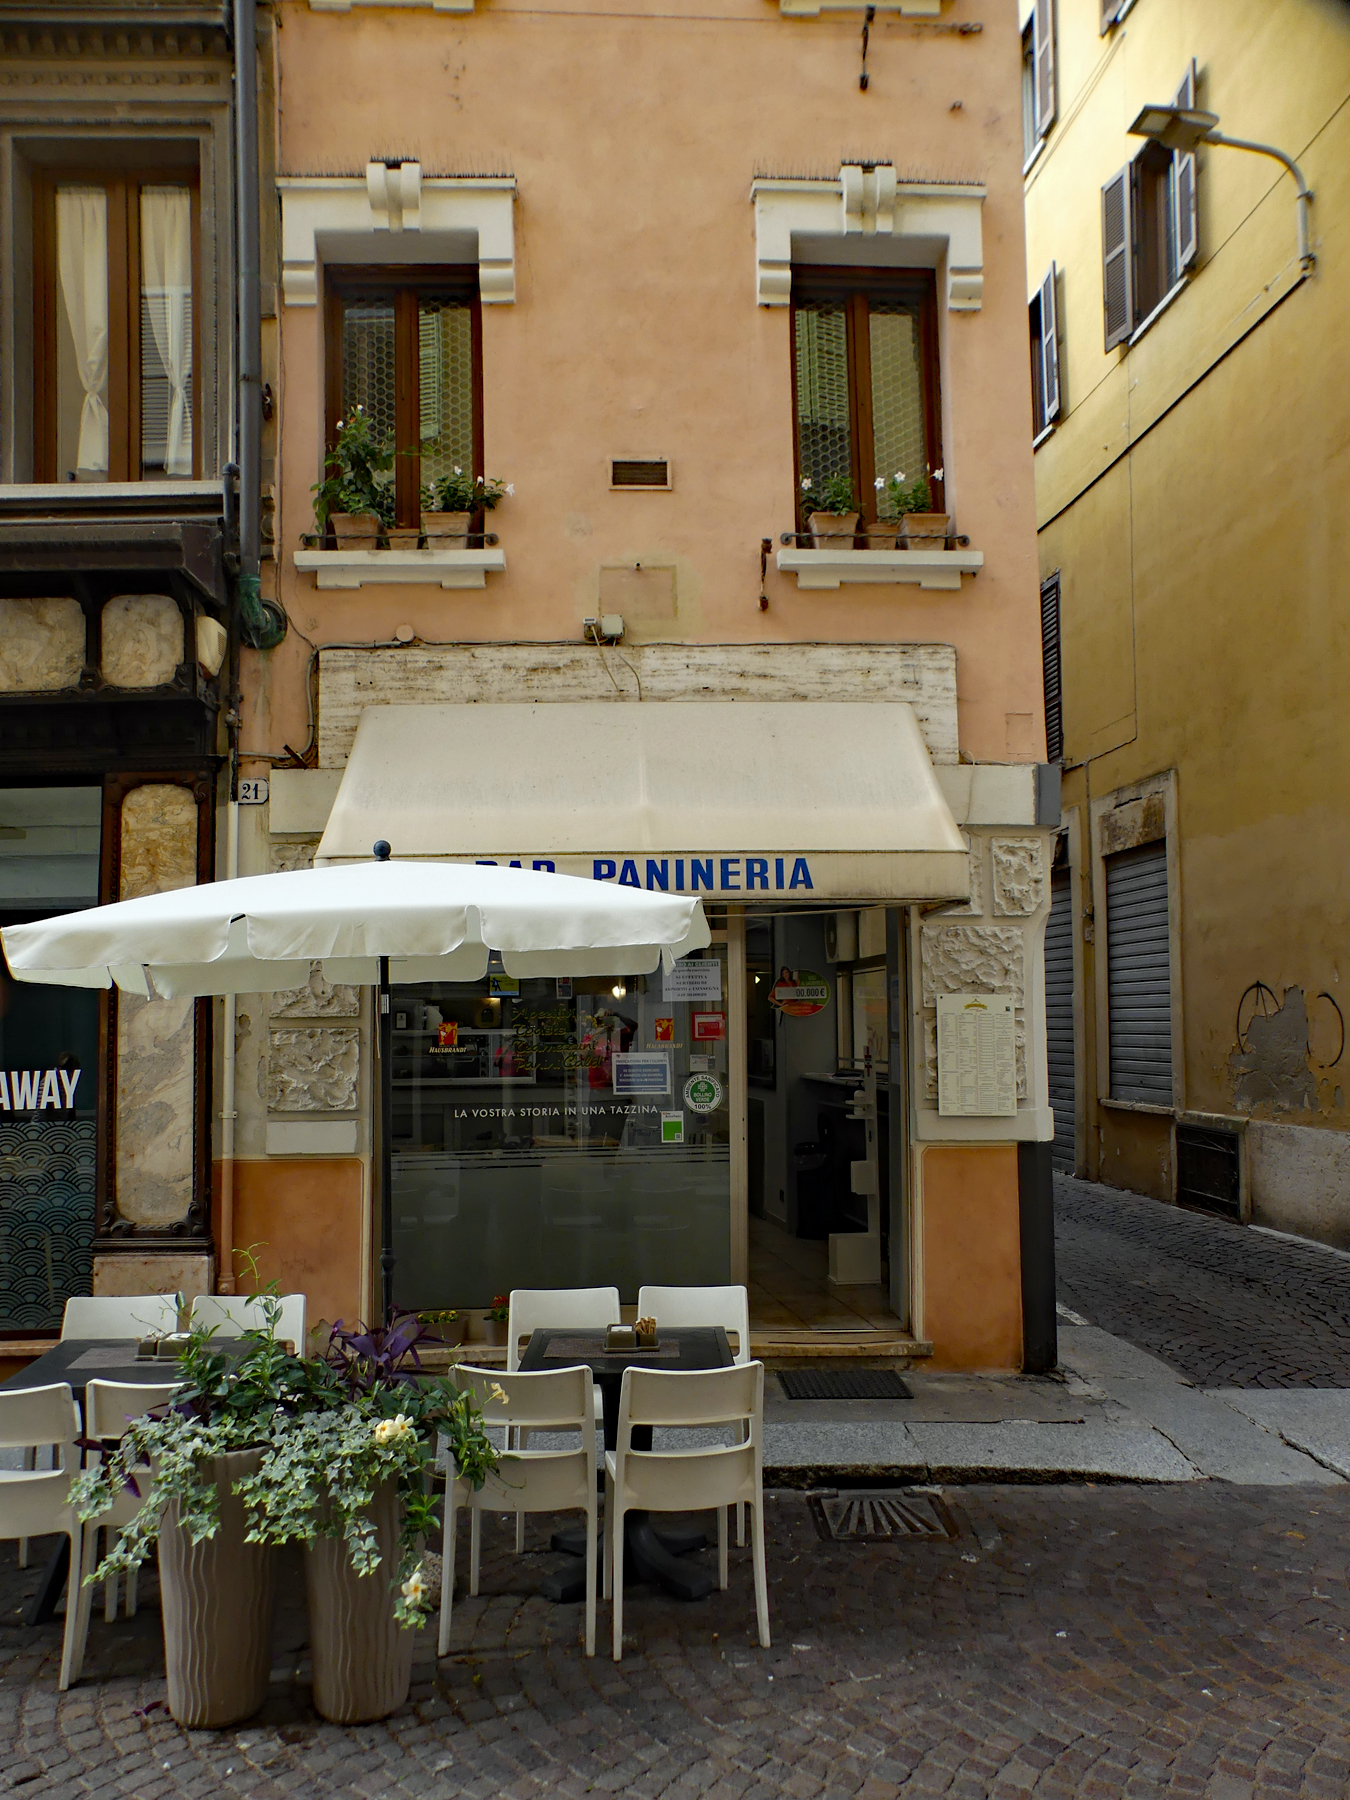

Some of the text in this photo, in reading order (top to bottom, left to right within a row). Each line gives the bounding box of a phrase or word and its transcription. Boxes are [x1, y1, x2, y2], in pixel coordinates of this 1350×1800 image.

[242, 783, 259, 800] 21
[593, 858, 814, 890] PANINERIA
[685, 1075, 720, 1098] AMBIENTE SANIFICATO
[454, 1109, 468, 1119] LA
[471, 1108, 516, 1119] VOSTRA
[520, 1106, 561, 1117] STORIA
[564, 1106, 577, 1116] IN
[581, 1105, 607, 1115] UNA
